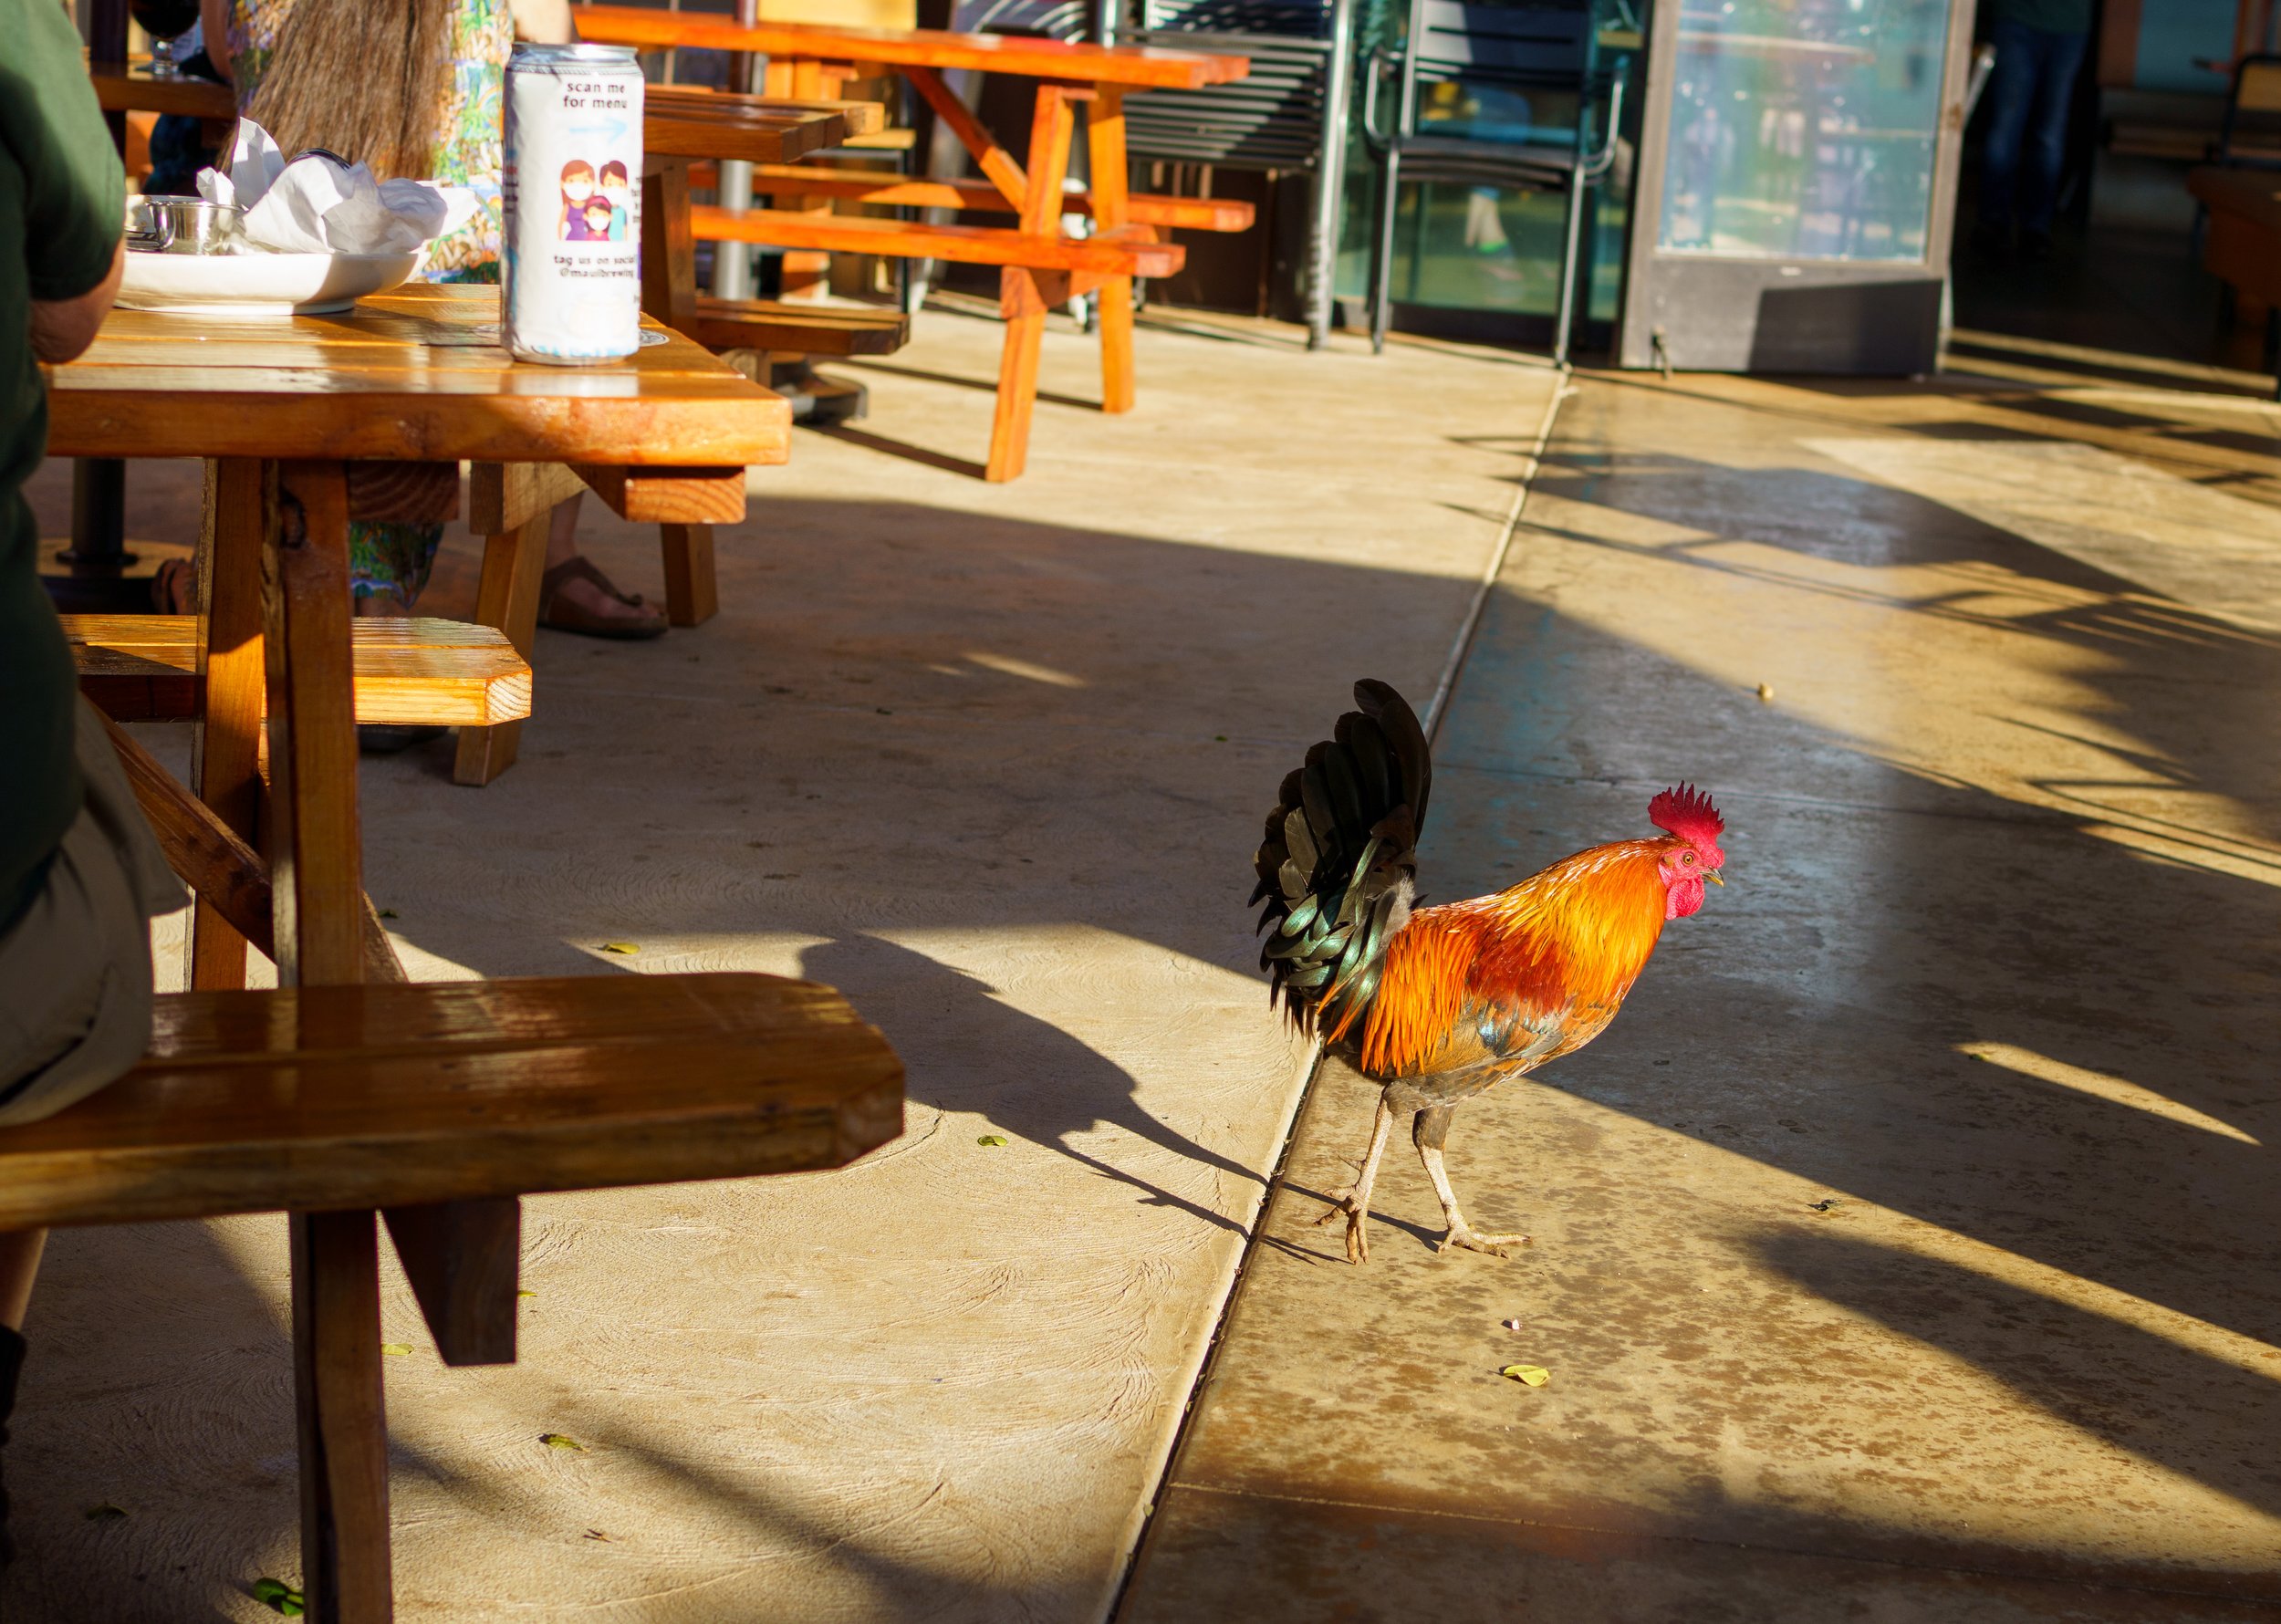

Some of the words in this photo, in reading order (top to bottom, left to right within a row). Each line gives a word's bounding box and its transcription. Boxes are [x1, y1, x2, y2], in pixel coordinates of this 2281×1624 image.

[567, 83, 601, 92] scan
[608, 84, 625, 93] me
[563, 95, 586, 107] for
[592, 99, 628, 109] menu
[554, 255, 573, 265] tag
